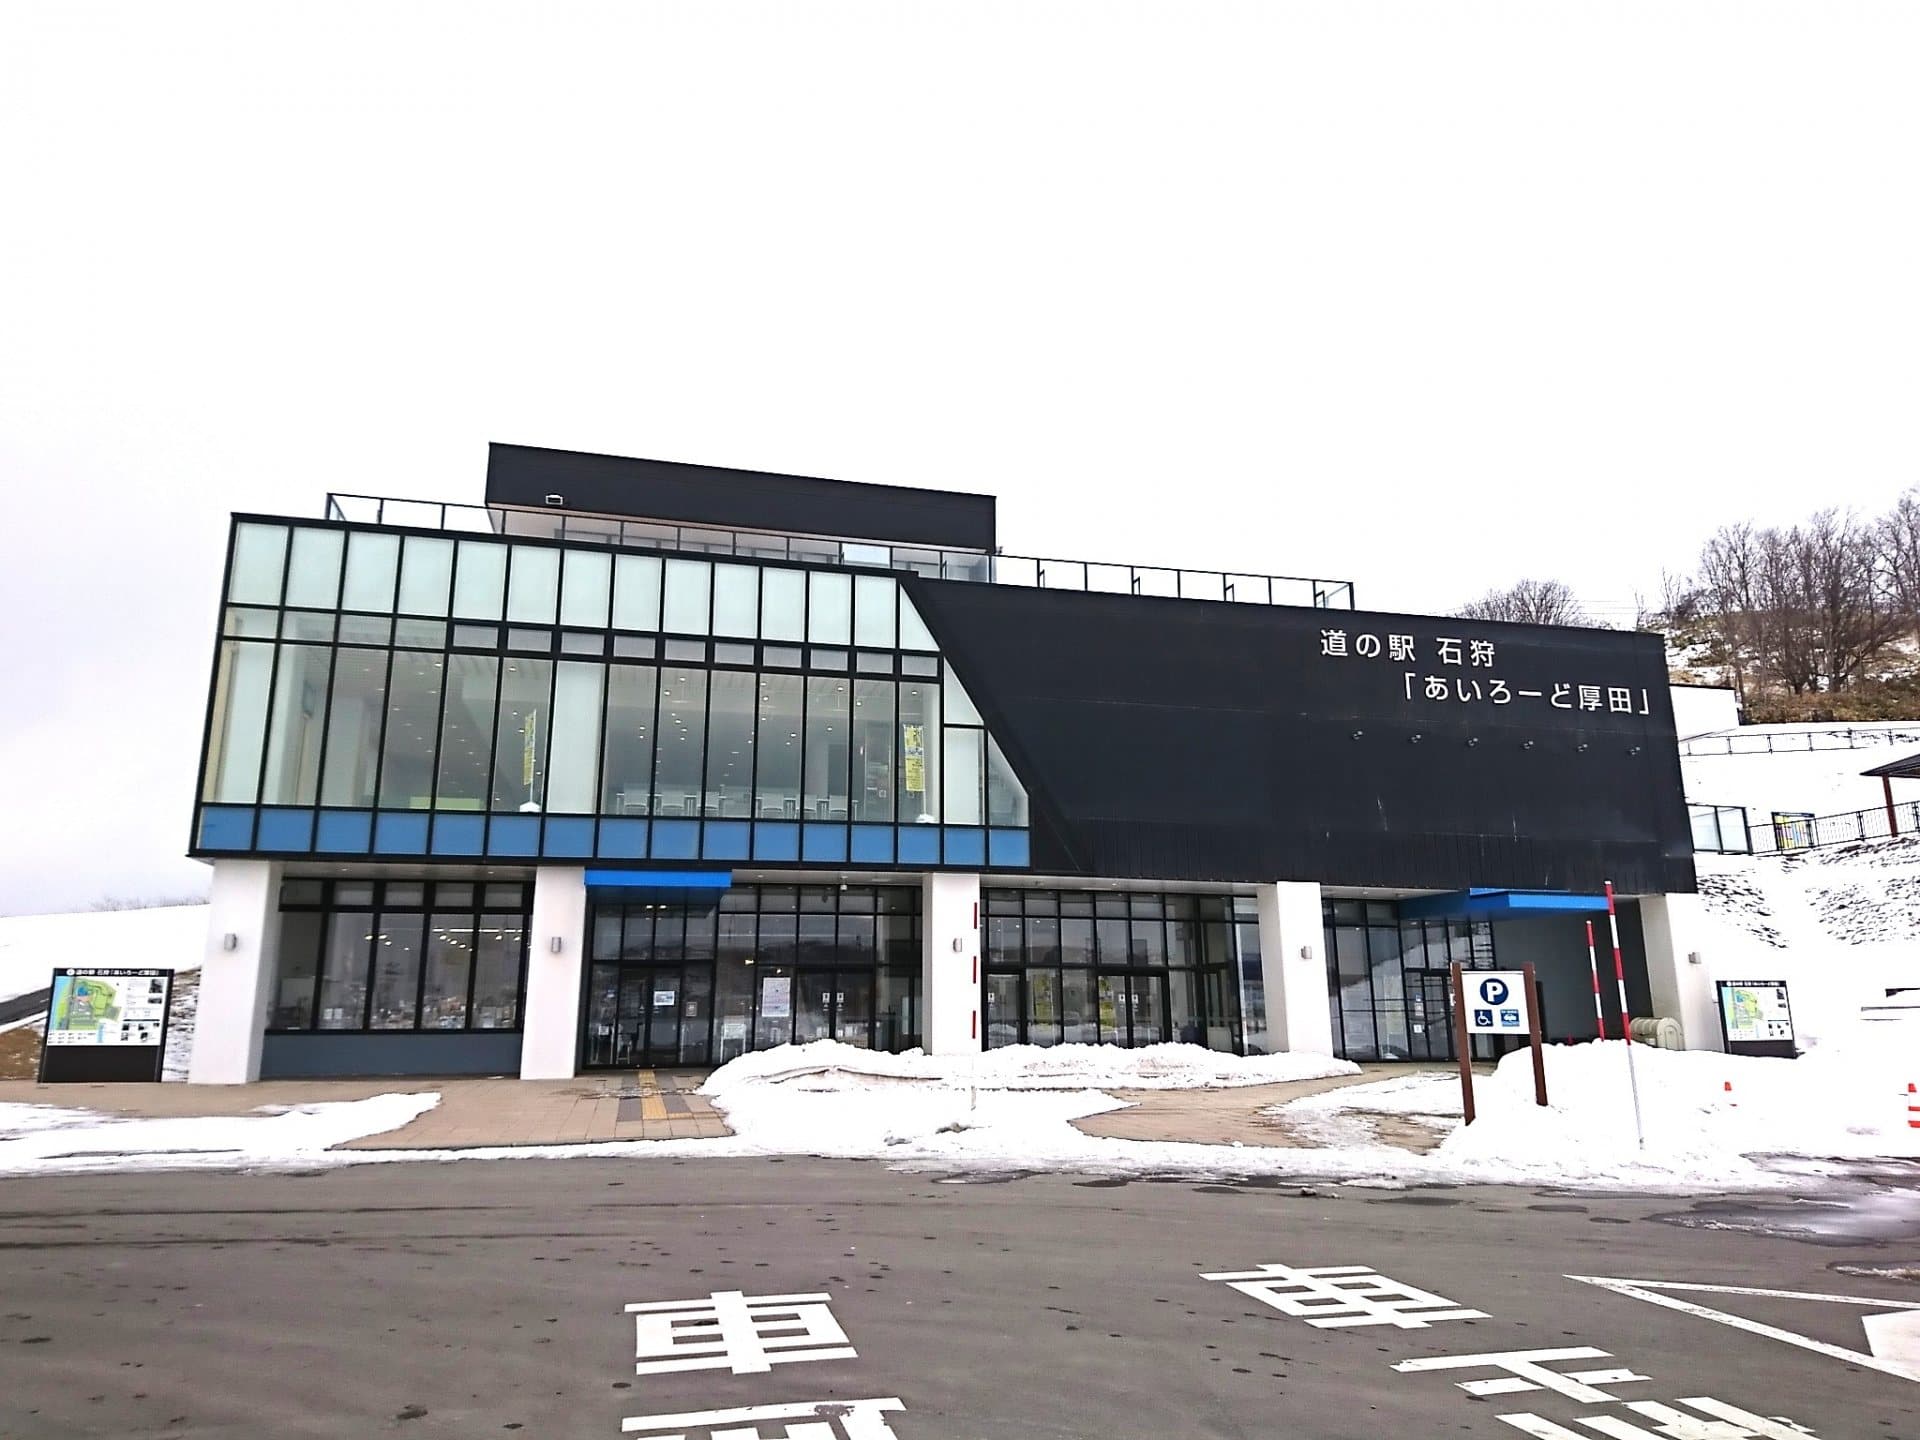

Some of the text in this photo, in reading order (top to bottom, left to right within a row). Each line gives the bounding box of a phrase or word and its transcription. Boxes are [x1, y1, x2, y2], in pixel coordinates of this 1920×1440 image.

[1320, 628, 1496, 669] 道の駅 石狩
[1402, 672, 1651, 716] 「あいろーど厚田」
[1486, 982, 1504, 1002] P
